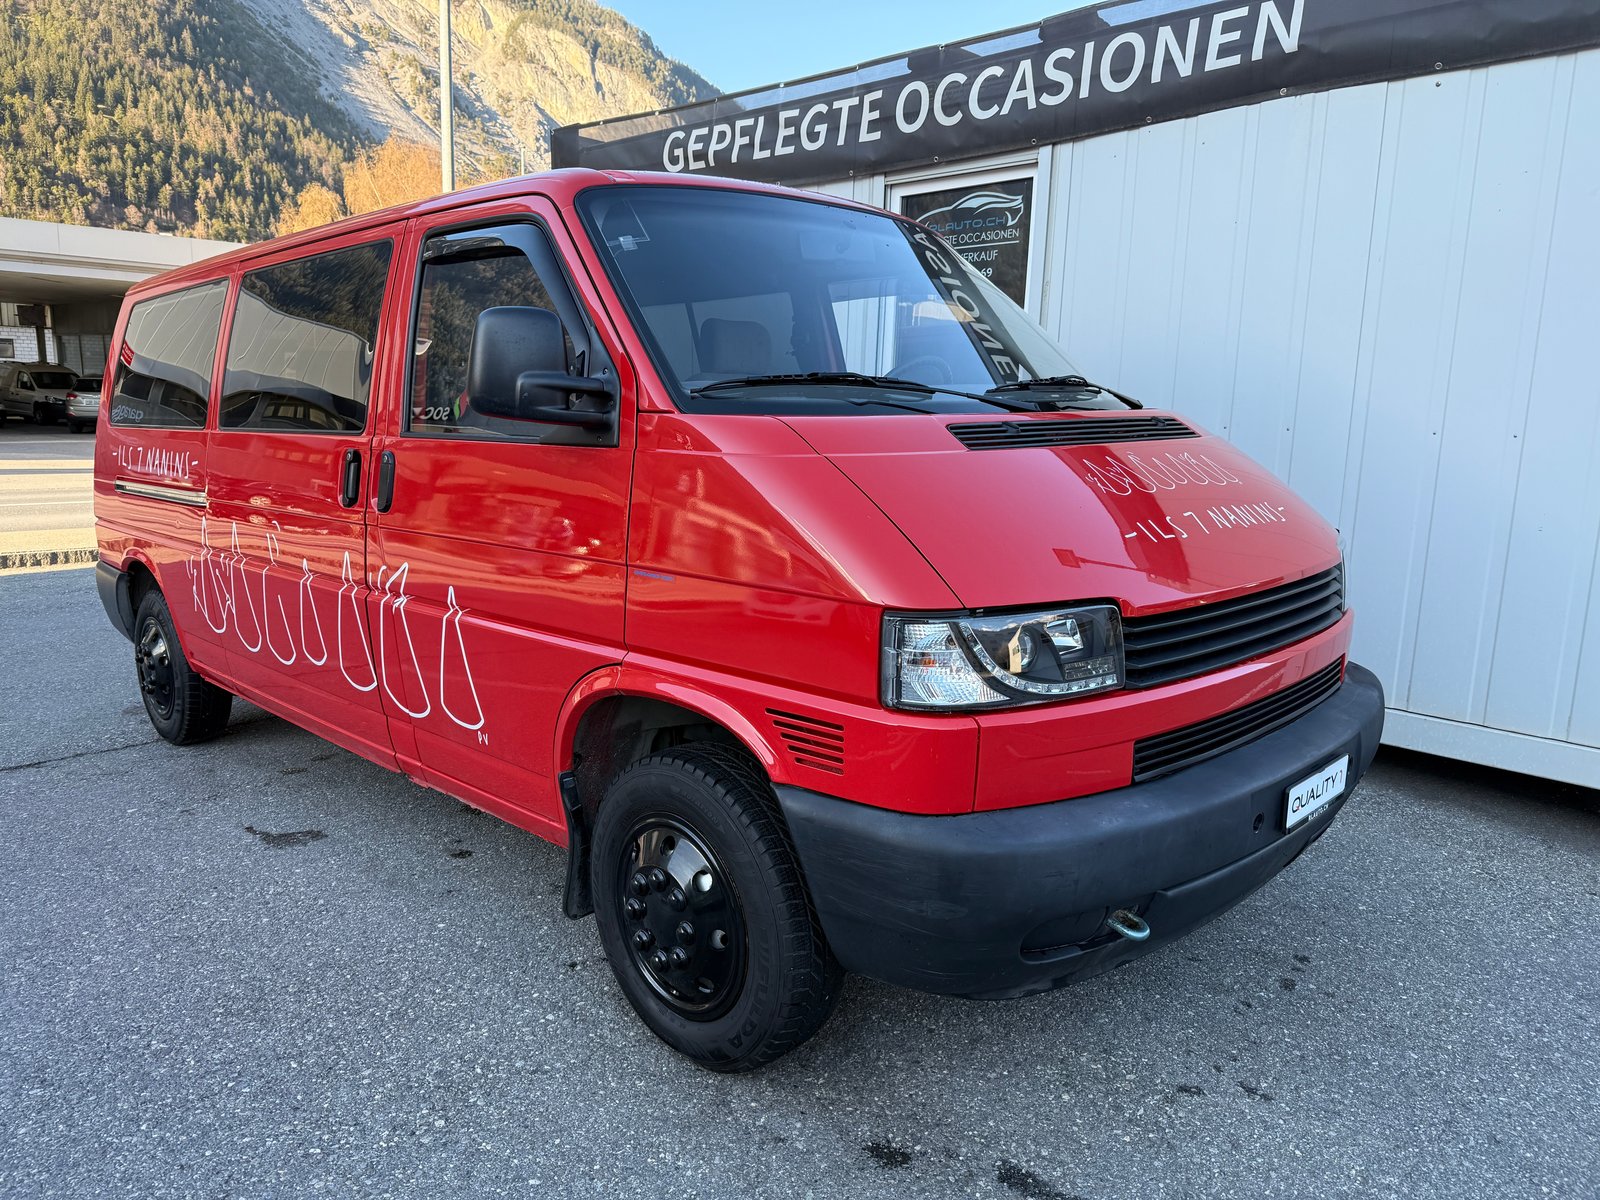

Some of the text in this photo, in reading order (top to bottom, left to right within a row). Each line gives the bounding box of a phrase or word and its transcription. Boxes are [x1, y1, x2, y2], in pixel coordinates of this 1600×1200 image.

[662, 0, 1304, 173] GEPFLEGTE OCCASIONEN
[959, 228, 1020, 244] OCCASIONEN
[137, 446, 143, 472] 7
[1183, 511, 1209, 534] 7
[1291, 771, 1338, 813] QUALITY
